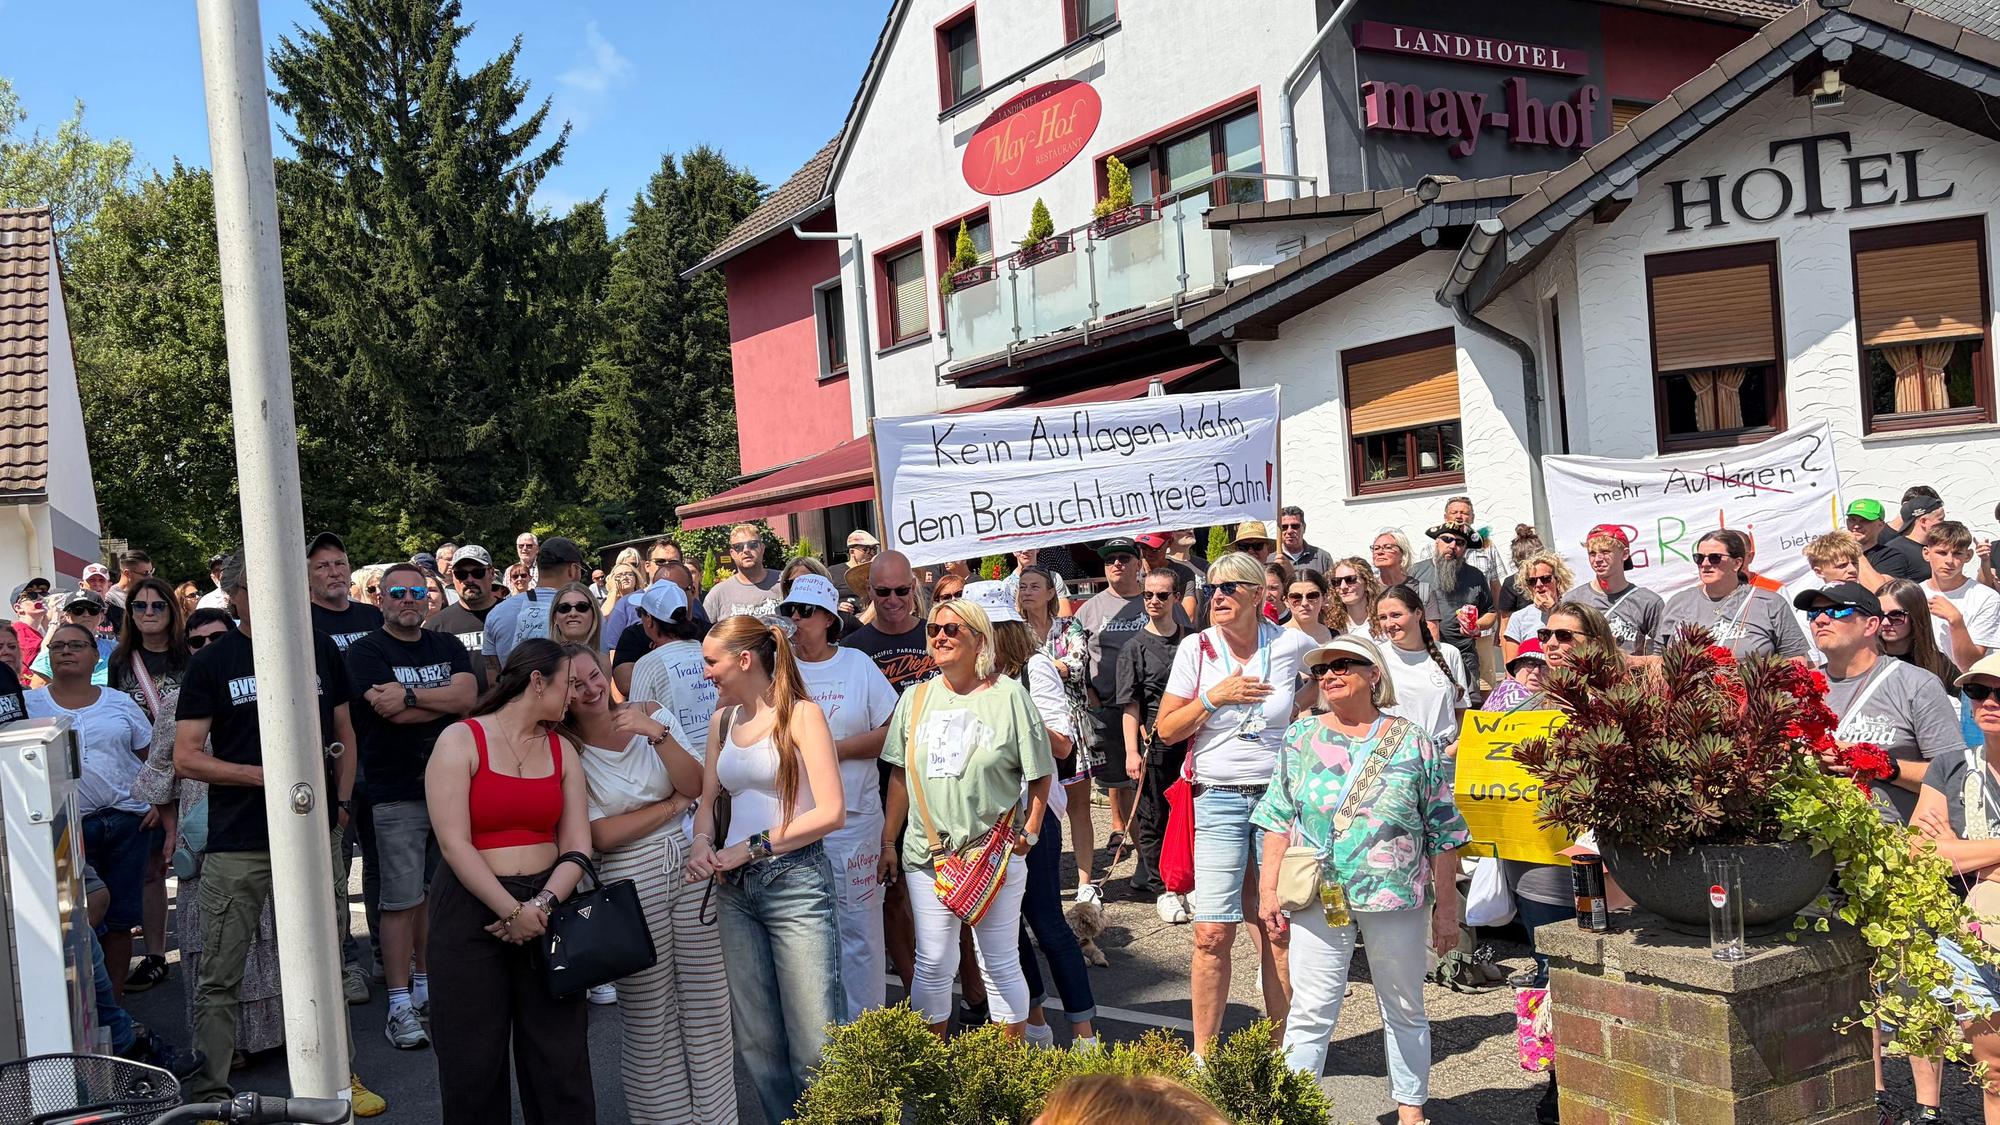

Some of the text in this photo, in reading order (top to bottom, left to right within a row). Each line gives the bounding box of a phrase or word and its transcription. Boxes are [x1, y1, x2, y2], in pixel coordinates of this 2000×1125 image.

[1393, 27, 1566, 70] LANDHOTEL
[998, 95, 1038, 121] LANDHOTEL
[1361, 76, 1601, 157] may-hof
[974, 98, 1087, 190] May-Hof
[1035, 136, 1083, 167] RESTAURANT
[1663, 130, 1955, 233] HOTEL
[931, 422, 1013, 468] Kein
[898, 499, 965, 546] dem
[1214, 460, 1274, 509] Bahn!
[1593, 479, 1643, 505] mehr
[870, 649, 893, 660] PACIFIC
[418, 663, 443, 683] 952
[669, 662, 705, 679] Tradit
[228, 677, 257, 699] BVB
[679, 708, 713, 727] Einsch
[1473, 715, 1527, 735] Wir
[1469, 782, 1548, 803] unser
